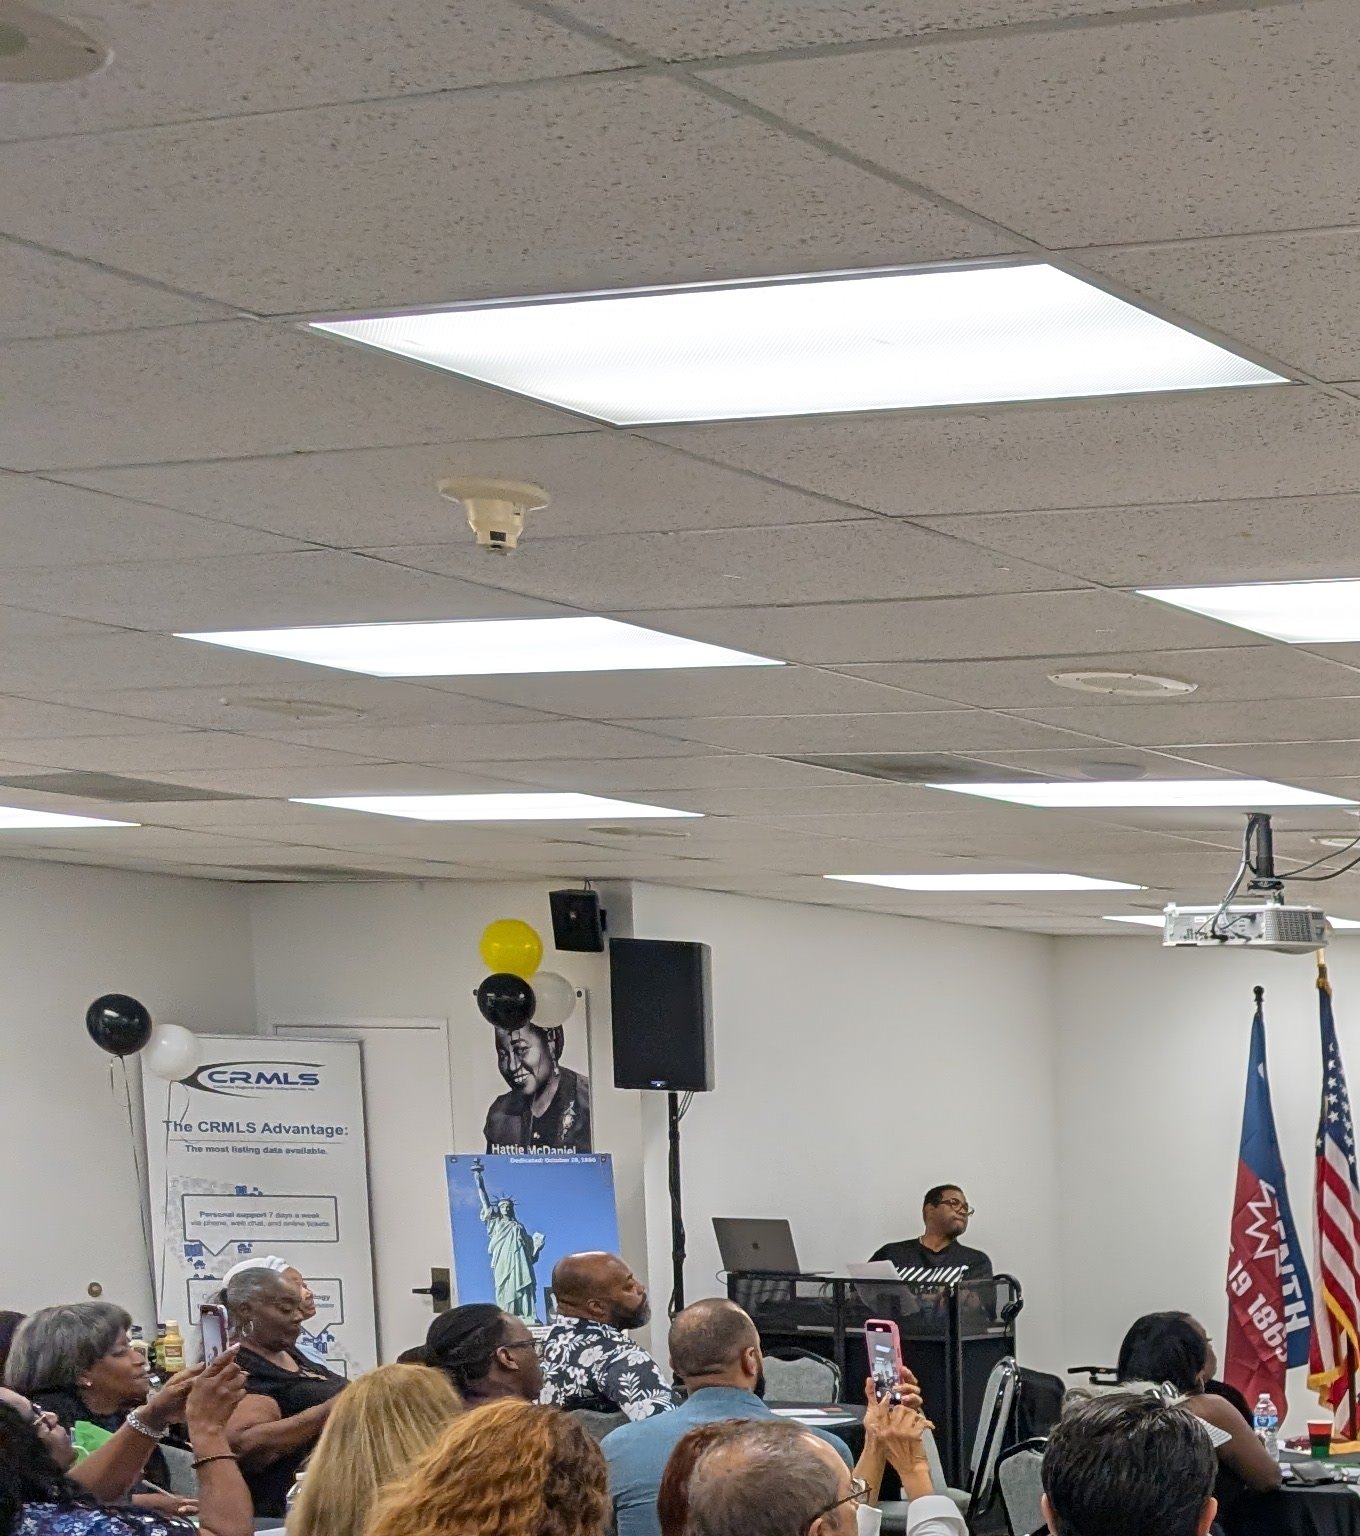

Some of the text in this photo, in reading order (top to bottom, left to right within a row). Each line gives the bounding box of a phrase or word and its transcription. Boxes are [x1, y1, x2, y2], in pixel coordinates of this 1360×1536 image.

[207, 1070, 320, 1086] CRMLS
[162, 1120, 349, 1138] The CRMLS Advantage:
[491, 1143, 577, 1155] Hattie McDaniel
